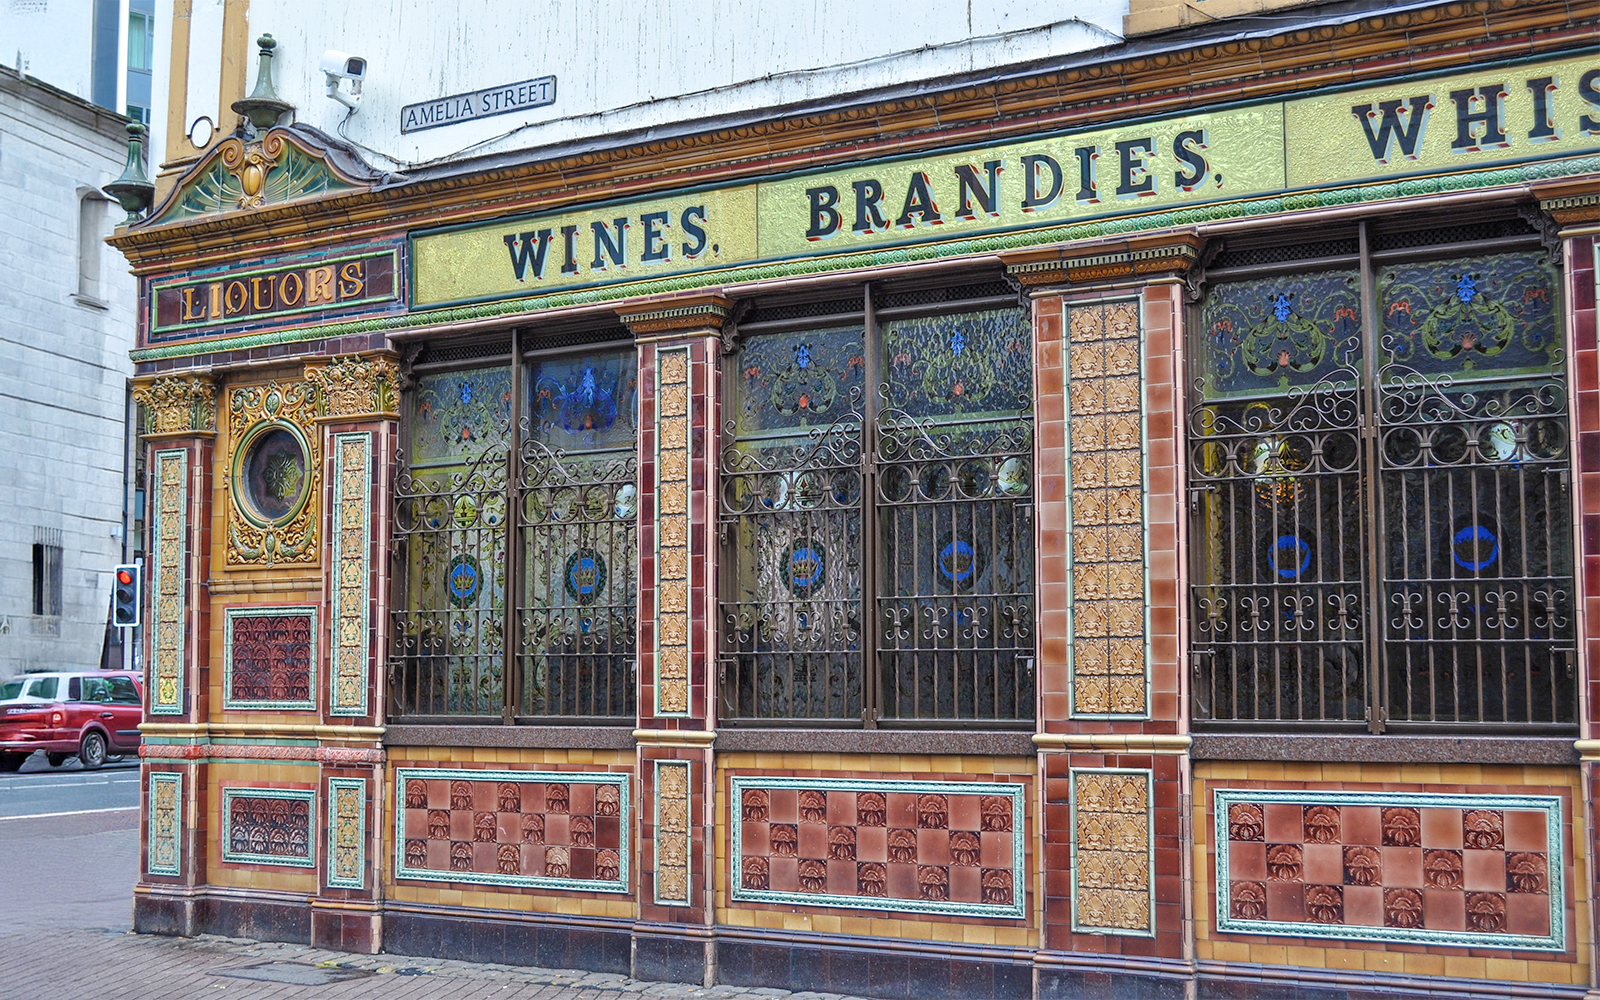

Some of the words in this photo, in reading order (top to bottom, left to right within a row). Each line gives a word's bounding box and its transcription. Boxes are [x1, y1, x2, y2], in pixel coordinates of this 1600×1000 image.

[406, 98, 473, 127] AMELIA
[482, 82, 550, 112] STREET
[503, 205, 720, 282] WINES,
[805, 128, 1224, 242] BRANDIES,
[183, 262, 364, 321] LIQUORS
